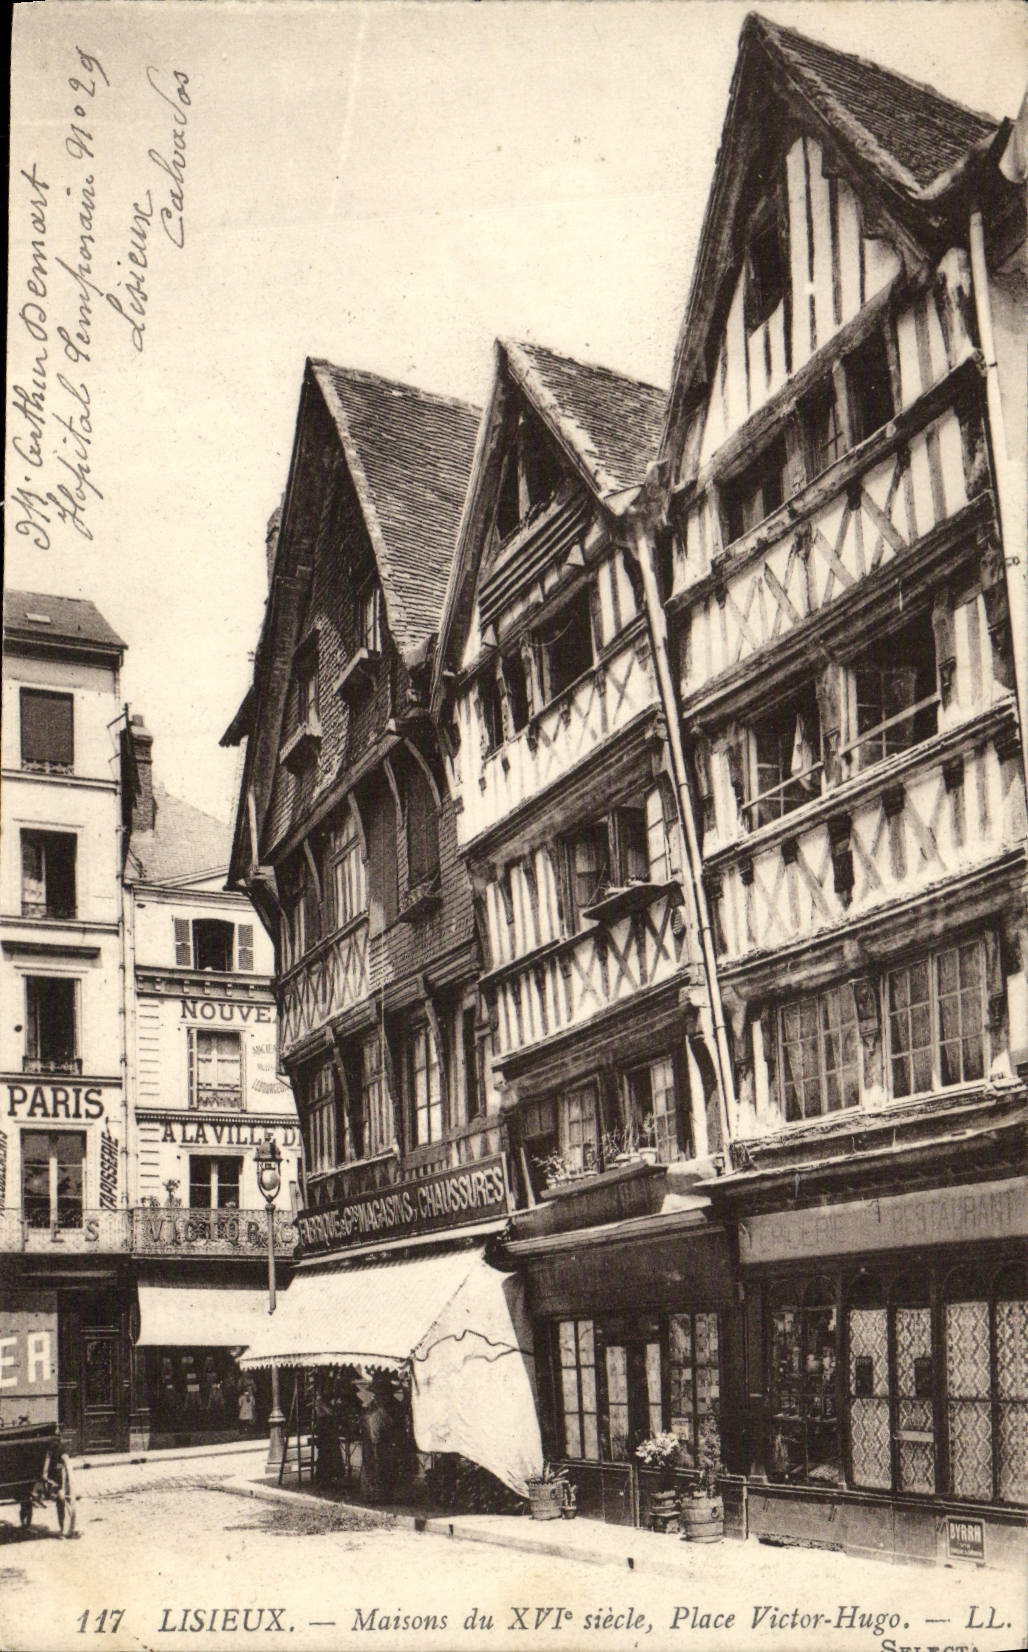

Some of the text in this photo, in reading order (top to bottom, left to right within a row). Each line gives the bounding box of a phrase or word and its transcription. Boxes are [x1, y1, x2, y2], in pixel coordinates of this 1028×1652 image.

[105, 189, 154, 352] Lisieux
[181, 1000, 278, 1023] NOUVE
[7, 1084, 104, 1119] PARIS
[282, 1126, 301, 1147] D
[99, 1128, 119, 1212] TAPISSERIE
[417, 1166, 505, 1217] CHAUSSURES
[950, 1522, 982, 1543] BYRRH
